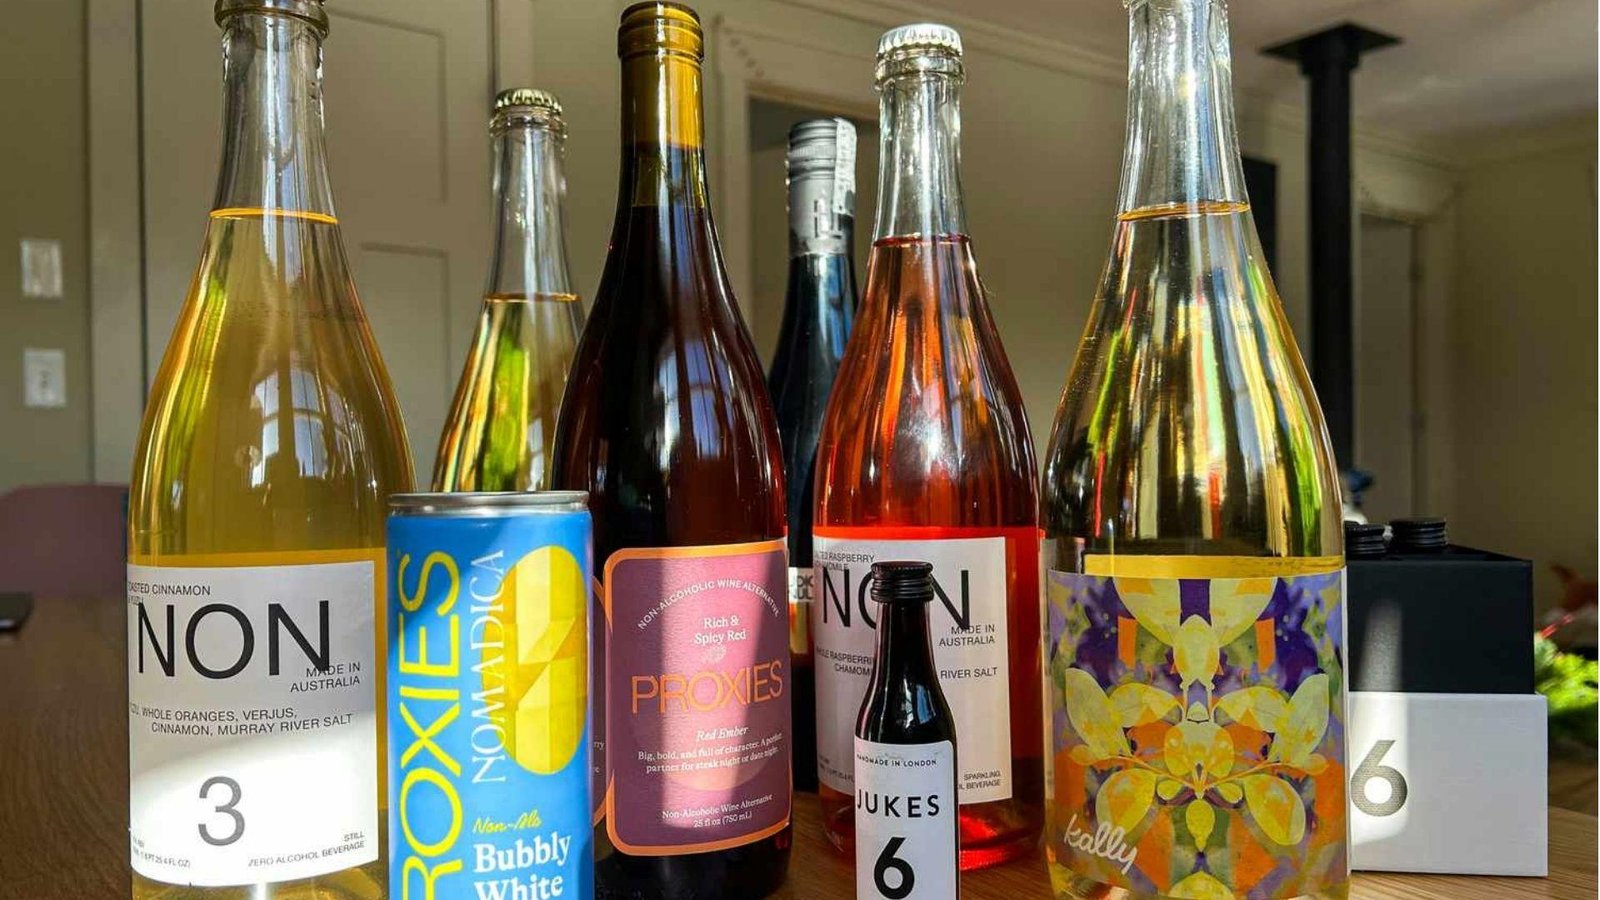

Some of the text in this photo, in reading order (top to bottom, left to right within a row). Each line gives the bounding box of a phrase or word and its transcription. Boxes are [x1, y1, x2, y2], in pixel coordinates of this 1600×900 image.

[829, 552, 875, 563] RASPBERRY
[151, 583, 211, 596] CINNAMON
[823, 568, 970, 630] NN
[637, 578, 780, 630] NON-ALCOHOLIC WINE ALTERNATIVE
[703, 614, 740, 629] Rich &
[950, 623, 996, 635] MADE IN
[137, 599, 331, 680] NON
[694, 629, 747, 646] Spicy Red
[938, 635, 996, 647] AUSTRALIA
[829, 651, 872, 664] RASPBERRI
[305, 661, 361, 678] MADE IN
[470, 550, 506, 785] NOMADICA
[834, 662, 871, 676] CHAMOM
[940, 666, 998, 679] RIVER SALT
[289, 676, 361, 693] AUSTRALIA
[630, 659, 783, 715] PROXIES
[142, 706, 172, 721] WHOLE
[174, 710, 240, 722] ORANGES,
[242, 706, 297, 721] VERJUS,
[151, 713, 354, 737] CINNAMON, MURRAY RIVER SALT
[399, 550, 464, 900] ROXIES
[696, 725, 750, 741] Red Ember
[637, 750, 656, 762] Big,
[656, 750, 679, 761] bold,
[679, 750, 697, 759] and
[698, 747, 714, 757] full
[714, 746, 725, 756] of
[760, 737, 767, 747] A
[645, 763, 681, 774] partner
[681, 761, 694, 771] for
[695, 760, 721, 770] steak
[720, 755, 741, 769] night
[856, 753, 937, 768] HANDMADE IN LONDON
[966, 779, 1001, 790] BEVERAGE
[1349, 739, 1409, 817] 6
[197, 775, 246, 847] 3
[662, 794, 773, 819] Non-Alcoholic Wine Alternative
[857, 788, 940, 819] JUKES
[693, 818, 704, 828] 25
[704, 818, 711, 827] fl
[343, 831, 365, 843] STILL
[1063, 813, 1138, 875] kally
[248, 840, 365, 867] ZERO ALCOHOL BEVERAGE
[473, 831, 572, 873] Bubbly
[873, 836, 915, 900] 6
[473, 873, 564, 900] White
